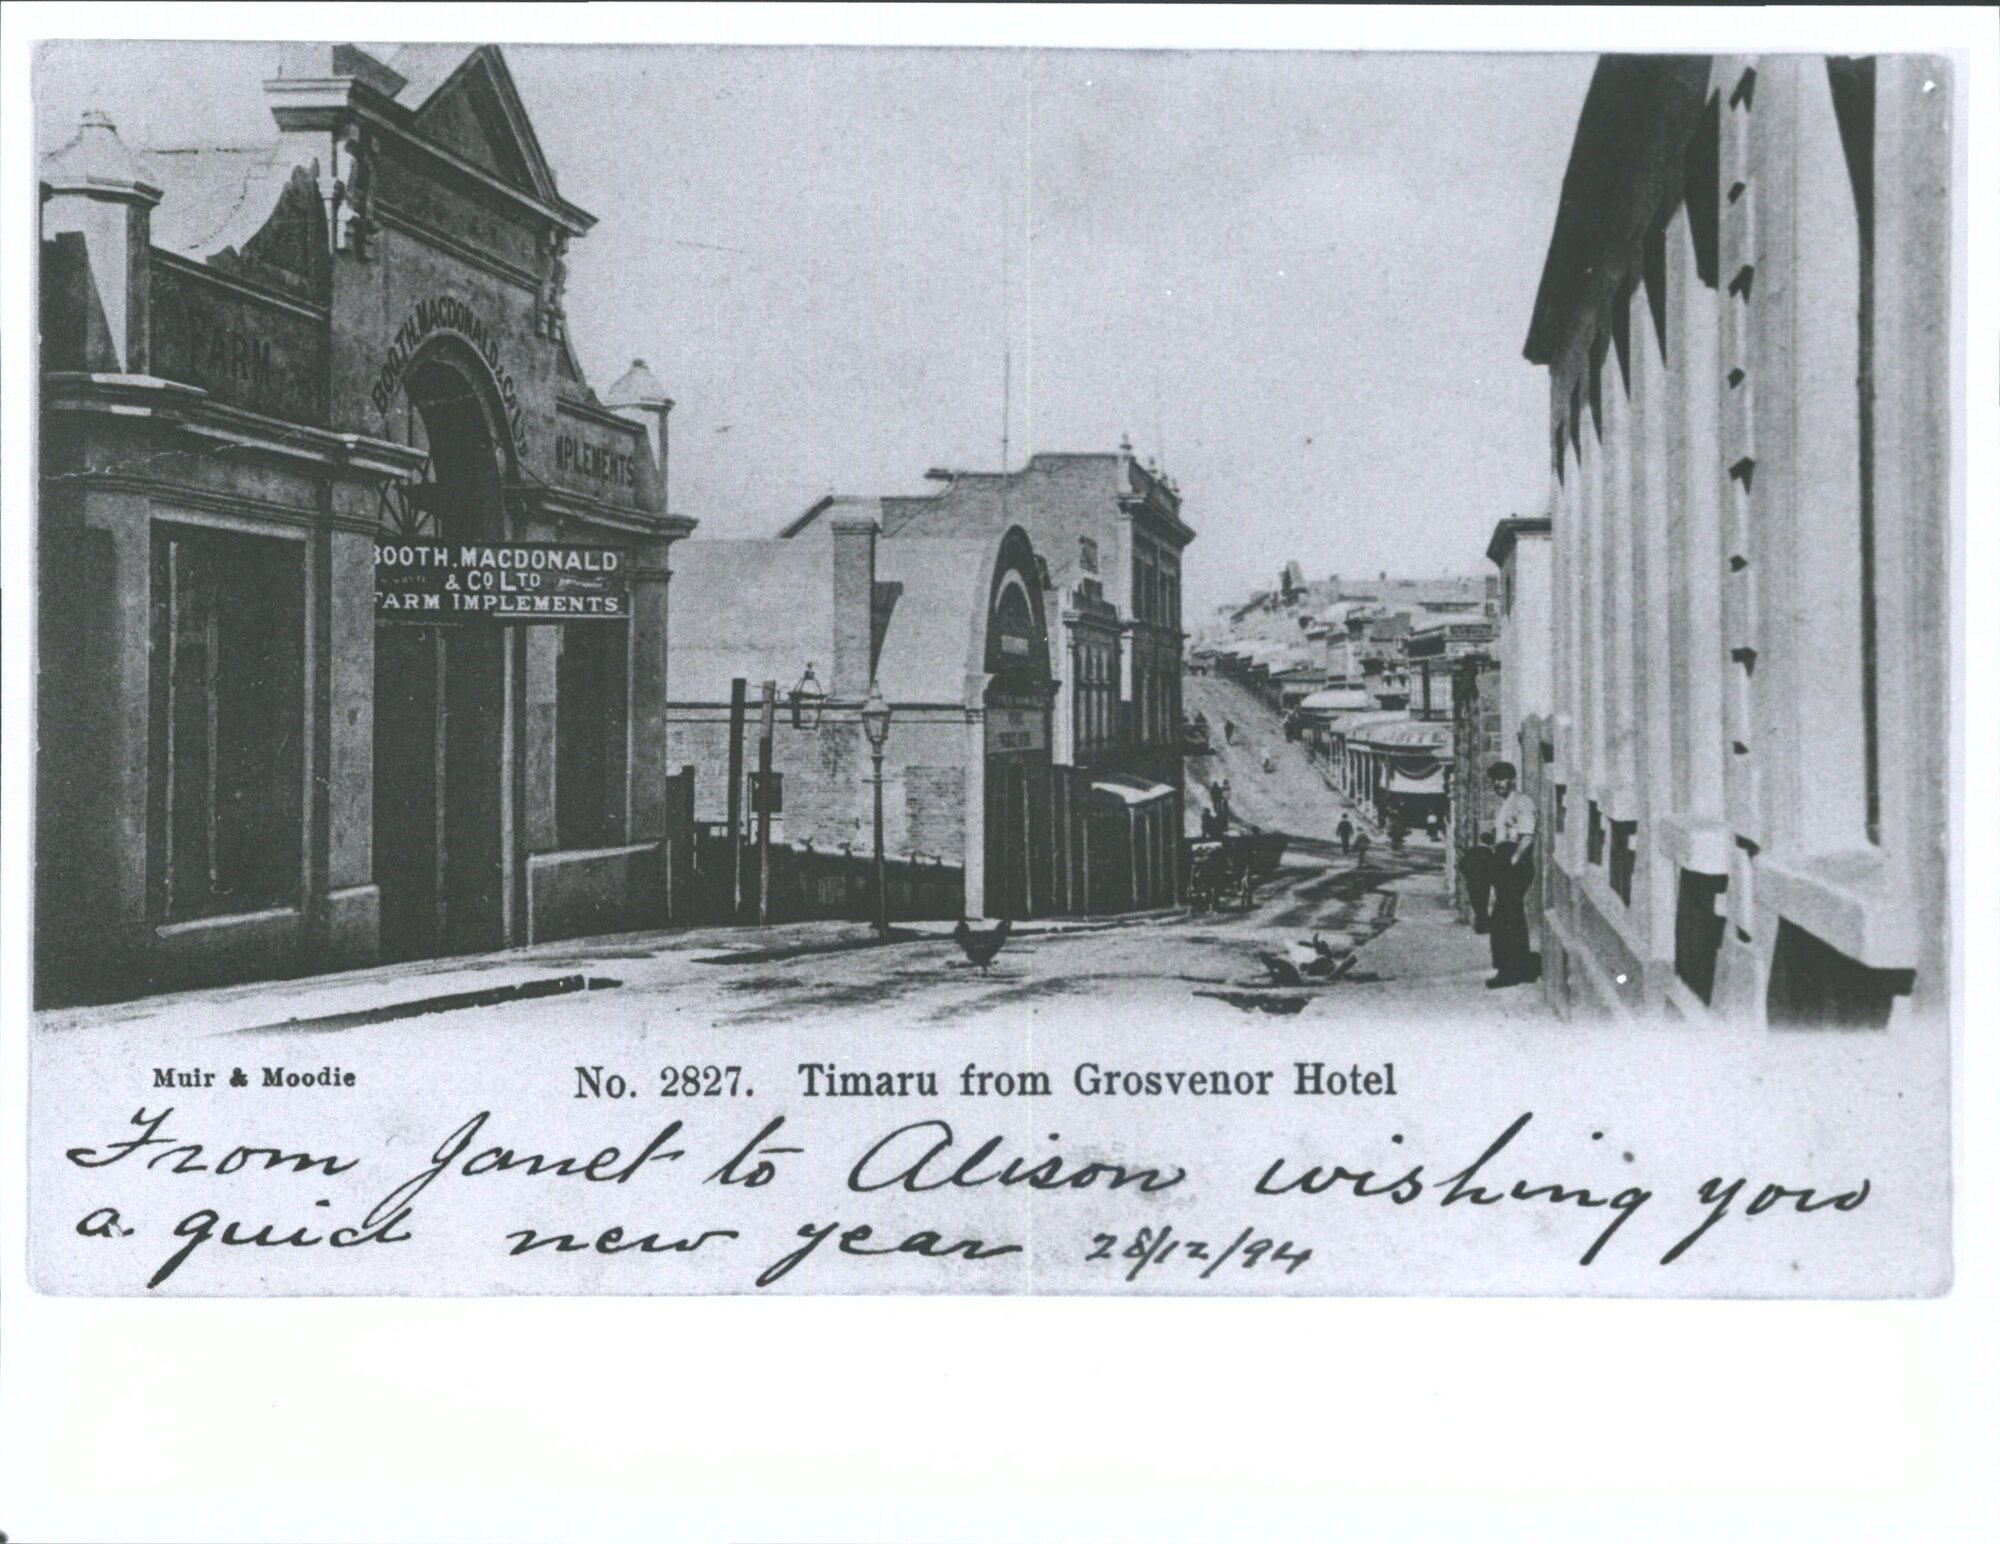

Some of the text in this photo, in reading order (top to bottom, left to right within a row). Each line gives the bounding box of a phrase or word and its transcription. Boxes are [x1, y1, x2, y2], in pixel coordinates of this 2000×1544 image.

[460, 546, 618, 571] MACDONALD
[444, 573, 461, 591] &
[451, 593, 619, 613] IMPLEMENTS
[66, 1107, 359, 1176] From
[362, 1110, 685, 1230] Janet
[704, 1115, 804, 1188] to
[847, 1119, 1187, 1193] Alison
[1254, 1111, 1653, 1267] wishing
[506, 1226, 740, 1256] new
[755, 1221, 1024, 1289] year
